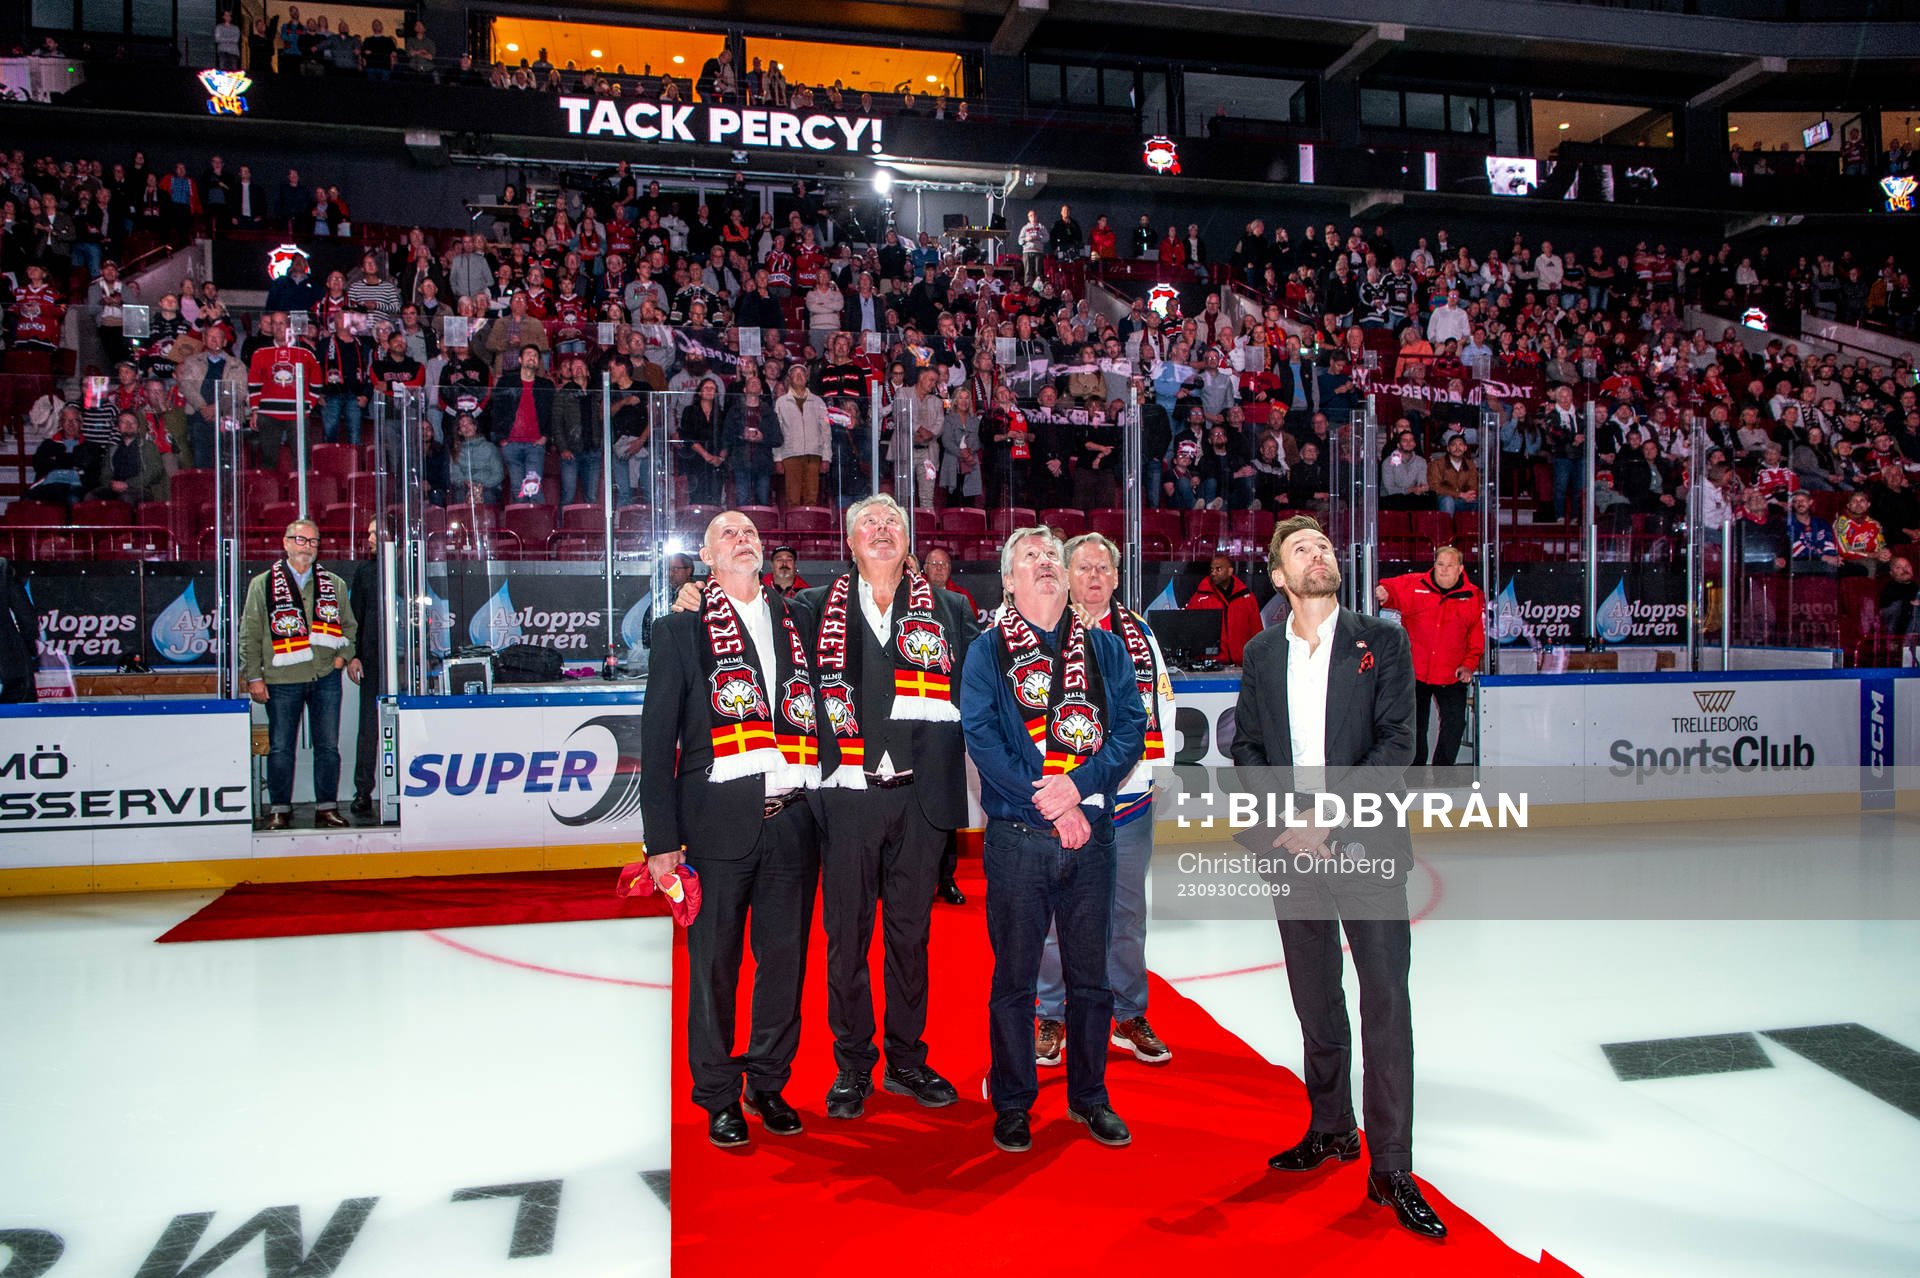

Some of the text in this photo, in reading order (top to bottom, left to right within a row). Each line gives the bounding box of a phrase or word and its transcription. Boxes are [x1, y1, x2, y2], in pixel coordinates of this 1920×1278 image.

[559, 97, 883, 154] TACK PERCY!
[490, 607, 601, 632] Avlopps
[1501, 600, 1581, 623] Avlopps
[1608, 600, 1687, 623] Avlopps
[1500, 621, 1571, 638] Jouren
[1607, 620, 1679, 637] Jouren
[1157, 672, 1176, 701] 4
[1672, 715, 1758, 733] TRELLEBORG
[1871, 691, 1884, 778] CCM
[1609, 735, 1815, 785] SportsClub
[404, 751, 598, 797] SUPER
